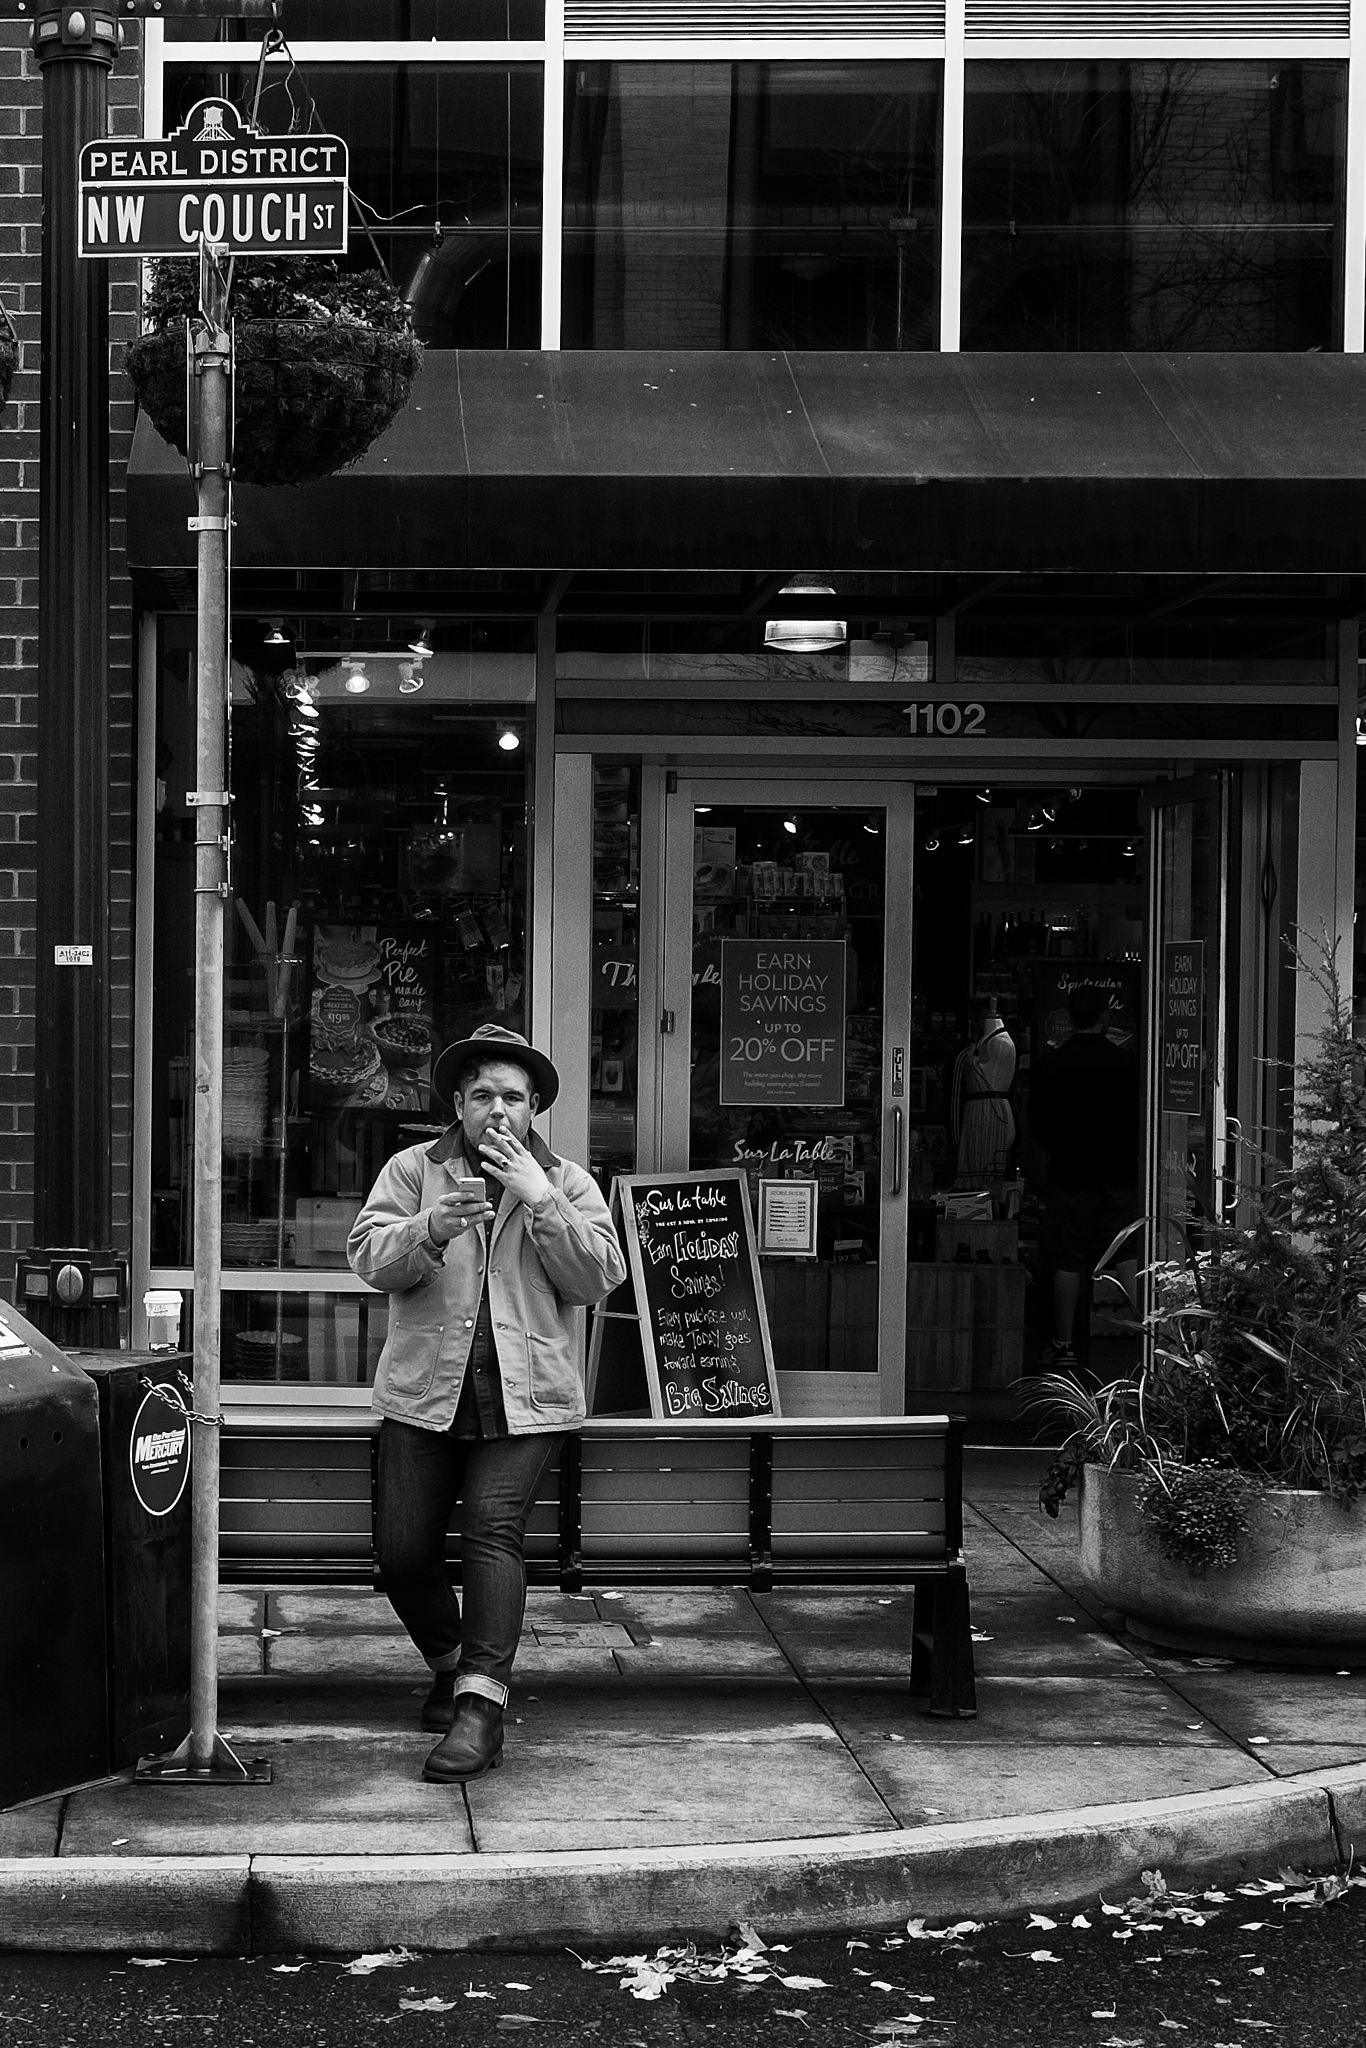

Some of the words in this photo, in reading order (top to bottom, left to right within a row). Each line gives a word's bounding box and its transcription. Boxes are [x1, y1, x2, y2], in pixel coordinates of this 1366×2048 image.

[90, 151, 187, 177] PEARL
[200, 147, 337, 175] DISTRICT
[87, 195, 145, 244] NW
[178, 192, 307, 243] COUCH
[313, 204, 335, 230] ST
[903, 703, 986, 735] 1102
[380, 937, 428, 964] Perfect
[757, 953, 811, 970] EARN
[382, 960, 419, 986] Pie
[1174, 955, 1193, 973] EARN
[394, 982, 427, 996] made
[738, 974, 829, 991] HOLIDAY
[1168, 977, 1198, 995] HOLIDAY
[398, 997, 427, 1012] easy
[740, 995, 827, 1012] SAVINGS
[1169, 999, 1197, 1017] SAVINGS
[764, 1023, 782, 1034] UP
[784, 1023, 801, 1034] TO
[729, 1037, 776, 1062] 20%
[780, 1037, 836, 1062] OFF
[1165, 1043, 1180, 1068] 20%
[1181, 1043, 1199, 1069] OFF
[894, 1049, 902, 1081] PULL
[732, 1139, 768, 1163] Sur
[771, 1140, 793, 1162] La
[794, 1140, 836, 1165] Table
[646, 1189, 674, 1215] Sur
[647, 1238, 674, 1265] Earn
[657, 1307, 683, 1331] Every
[684, 1306, 727, 1328] purchase
[730, 1308, 751, 1330] you
[659, 1333, 686, 1349] make
[724, 1331, 751, 1350] goes
[664, 1353, 696, 1370] toward
[699, 1354, 740, 1374] earning
[134, 1434, 185, 1464] MERCURY
